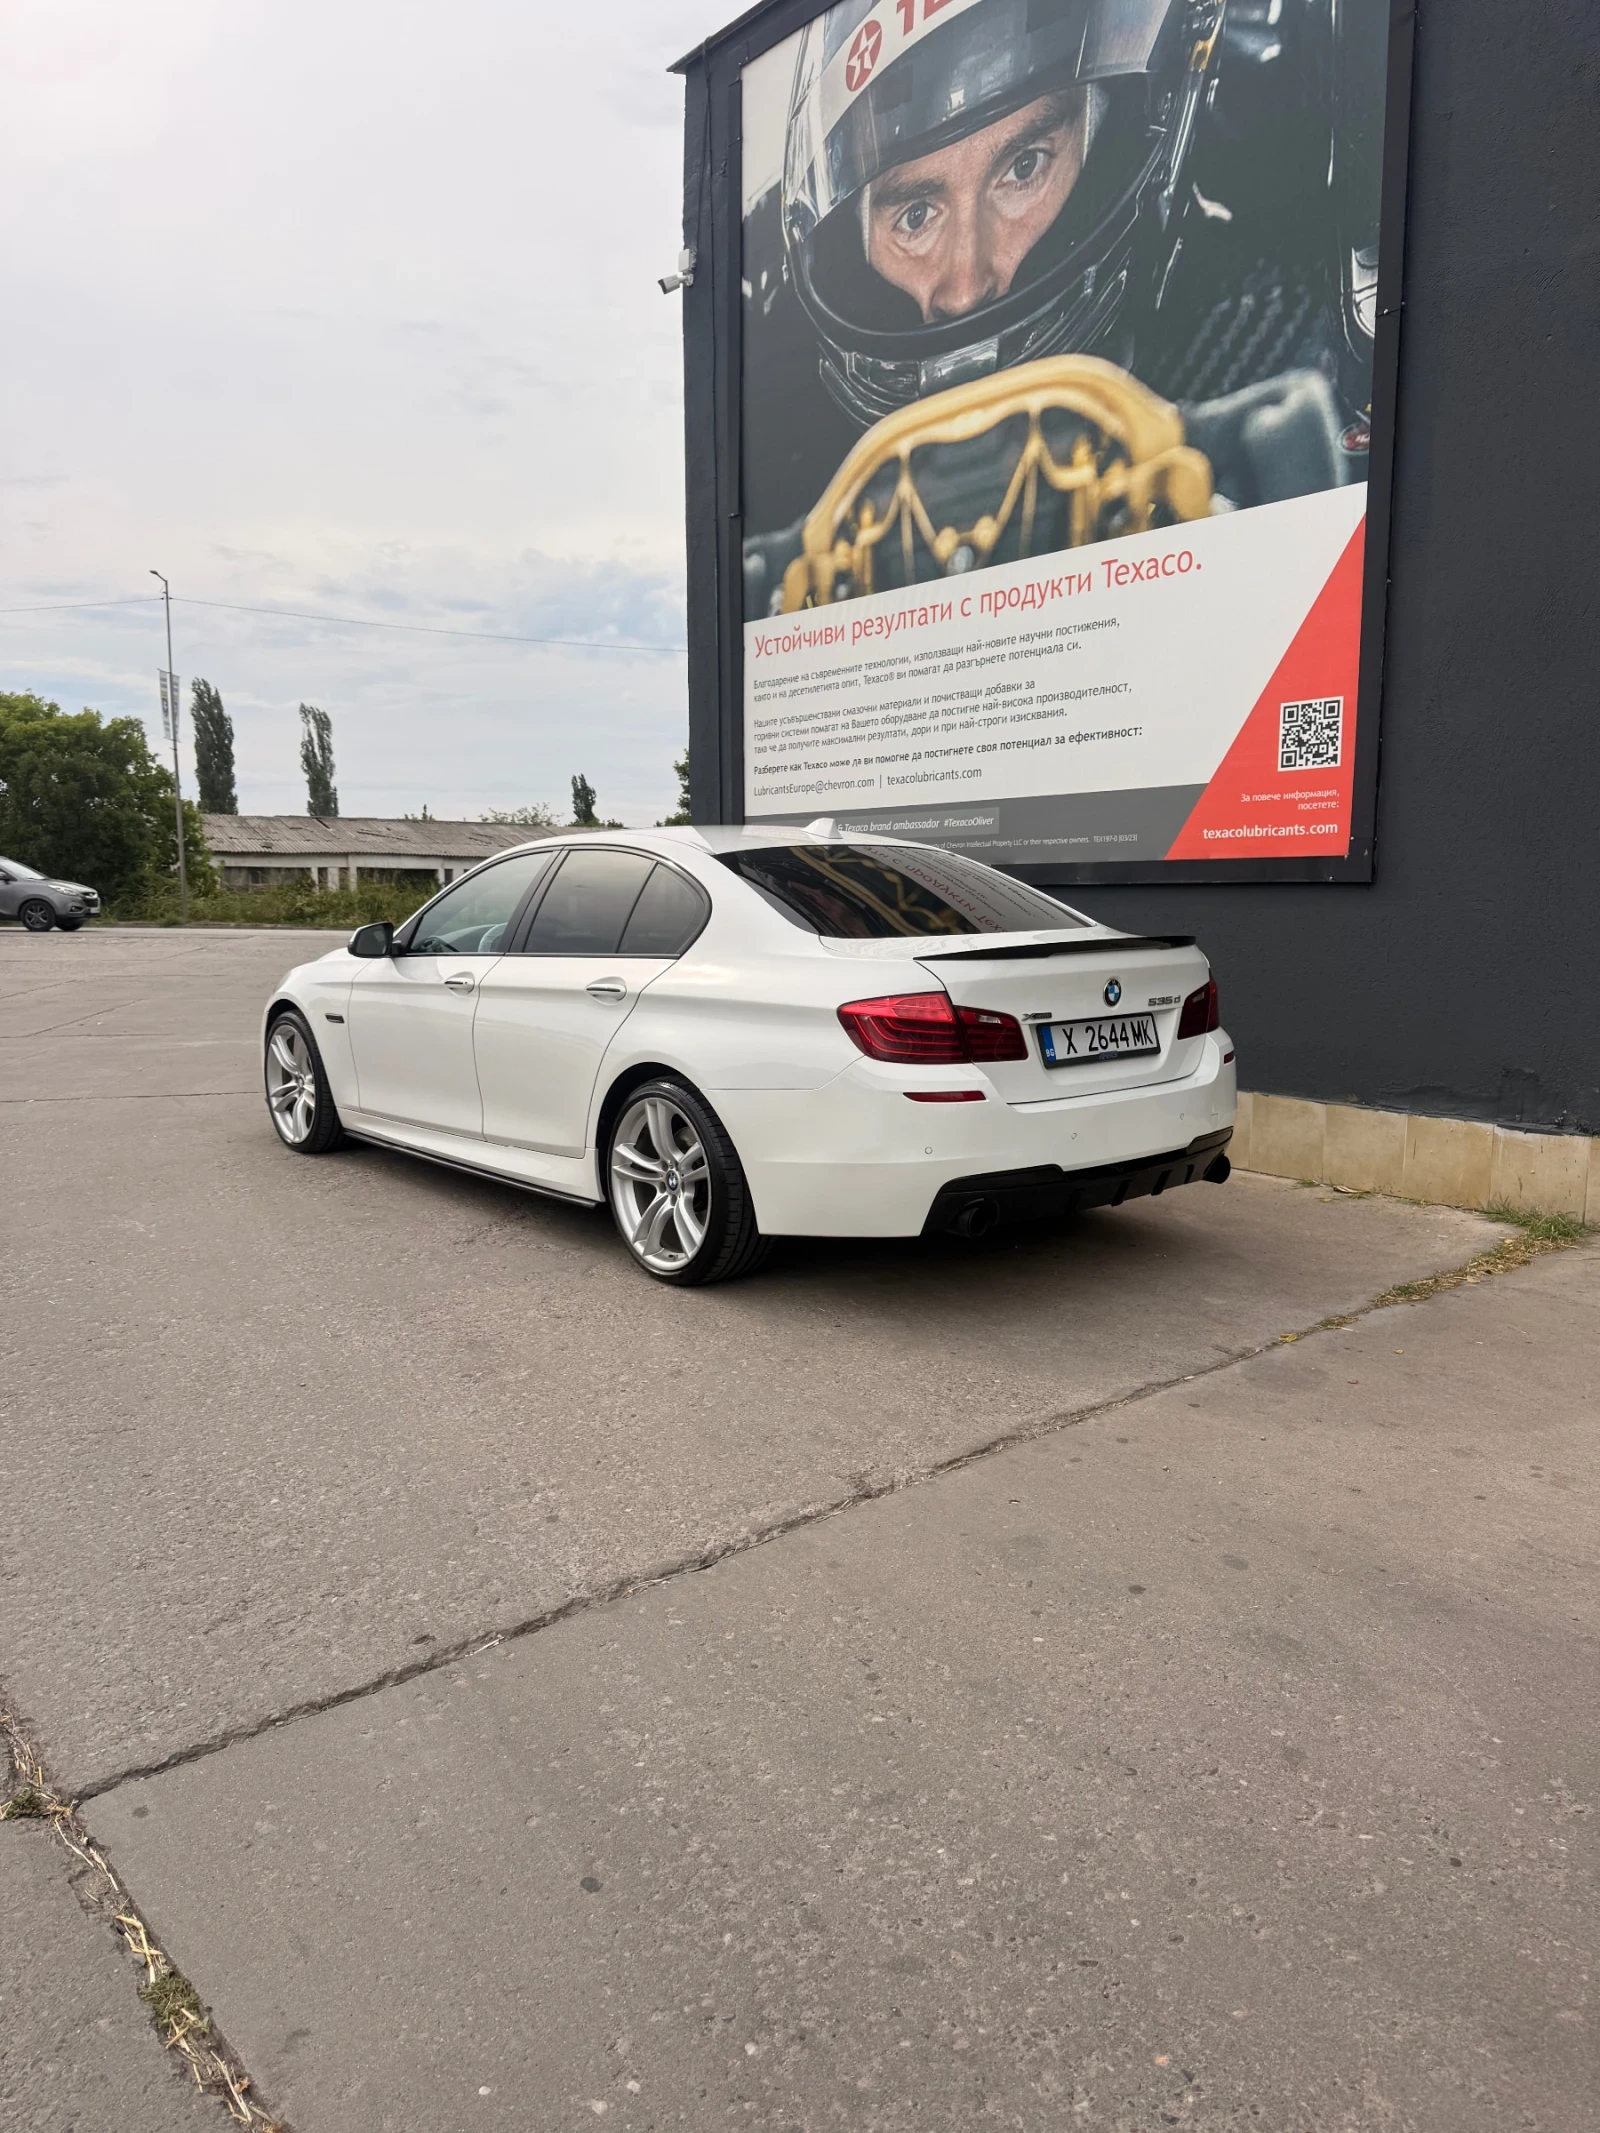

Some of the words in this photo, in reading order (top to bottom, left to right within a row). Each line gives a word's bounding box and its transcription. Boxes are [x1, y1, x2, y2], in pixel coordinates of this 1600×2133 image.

[755, 624, 845, 658] Устойчиви
[852, 601, 952, 646] резултати
[960, 597, 971, 617] с
[980, 571, 1092, 618] продукти
[1101, 550, 1202, 588] Texaco.
[754, 675, 799, 690] Благодарение
[801, 674, 810, 682] на
[811, 665, 863, 681] съвременните
[864, 656, 912, 671] технологии,
[914, 645, 964, 662] използващи
[966, 635, 1017, 653] най-новите
[1019, 629, 1053, 645] научни
[1056, 617, 1120, 637] постижения,
[754, 692, 771, 703] както
[773, 692, 778, 700] и
[779, 690, 787, 699] на
[788, 683, 840, 699] десетилетията
[841, 679, 861, 690] опит,
[897, 670, 907, 680] ви
[908, 666, 941, 678] помагат
[943, 662, 954, 674] да
[956, 654, 1006, 672] разгърнете
[1008, 644, 1064, 661] потенциала
[1066, 640, 1082, 651] си.
[754, 732, 780, 743] горивни
[781, 727, 810, 738] системи
[811, 723, 839, 734] помагат
[841, 722, 850, 731] на
[852, 717, 879, 730] Вашето
[881, 710, 927, 726] оборудване
[929, 708, 940, 719] да
[942, 703, 980, 718] постигне
[982, 696, 1034, 712] най-висока
[1036, 682, 1132, 704] производителност,
[780, 709, 841, 728] усъвършенствани
[842, 704, 878, 716] смазочни
[879, 696, 922, 712] материали
[924, 696, 930, 704] и
[931, 687, 982, 705] почистващи
[985, 680, 1022, 697] добавки
[1025, 680, 1035, 690] за
[754, 744, 768, 754] така
[769, 744, 777, 752] че
[778, 742, 787, 752] да
[788, 736, 820, 751] получите
[821, 734, 866, 747] максимални
[867, 728, 909, 743] резултати,
[911, 726, 932, 738] дори
[934, 724, 939, 733] и
[941, 721, 957, 734] при
[959, 714, 1008, 730] най-строги
[1010, 707, 1068, 724] изисквания.
[754, 762, 788, 775] Разберете
[789, 762, 802, 772] как
[830, 758, 850, 768] може
[852, 758, 862, 768] да
[864, 756, 874, 766] ви
[875, 752, 910, 764] помогне
[912, 751, 922, 761] да
[924, 745, 974, 759] постигнете
[976, 743, 998, 754] своя
[1000, 737, 1052, 751] потенциал
[1054, 735, 1066, 745] за
[1068, 726, 1143, 745] ефективност:
[754, 776, 874, 797] LubricantsEurope@chevron.com
[887, 767, 982, 786] texacolubricants.com
[1241, 794, 1250, 803] За
[1252, 793, 1282, 802] повече
[1283, 789, 1340, 800] информация,
[1298, 801, 1339, 811] посетете:
[845, 823, 868, 832] Texaco
[870, 821, 891, 832] brand
[893, 819, 940, 830] ambassador
[944, 816, 994, 828] #TexacoOliver
[1203, 823, 1338, 839] texacolubricants.com
[946, 841, 966, 849] Chevron
[993, 840, 1012, 848] Property
[1030, 838, 1041, 846] their
[1043, 837, 1068, 845] respective
[1069, 836, 1090, 844] owners.
[1046, 1048, 1055, 1057] BG
[1062, 1028, 1078, 1055] X
